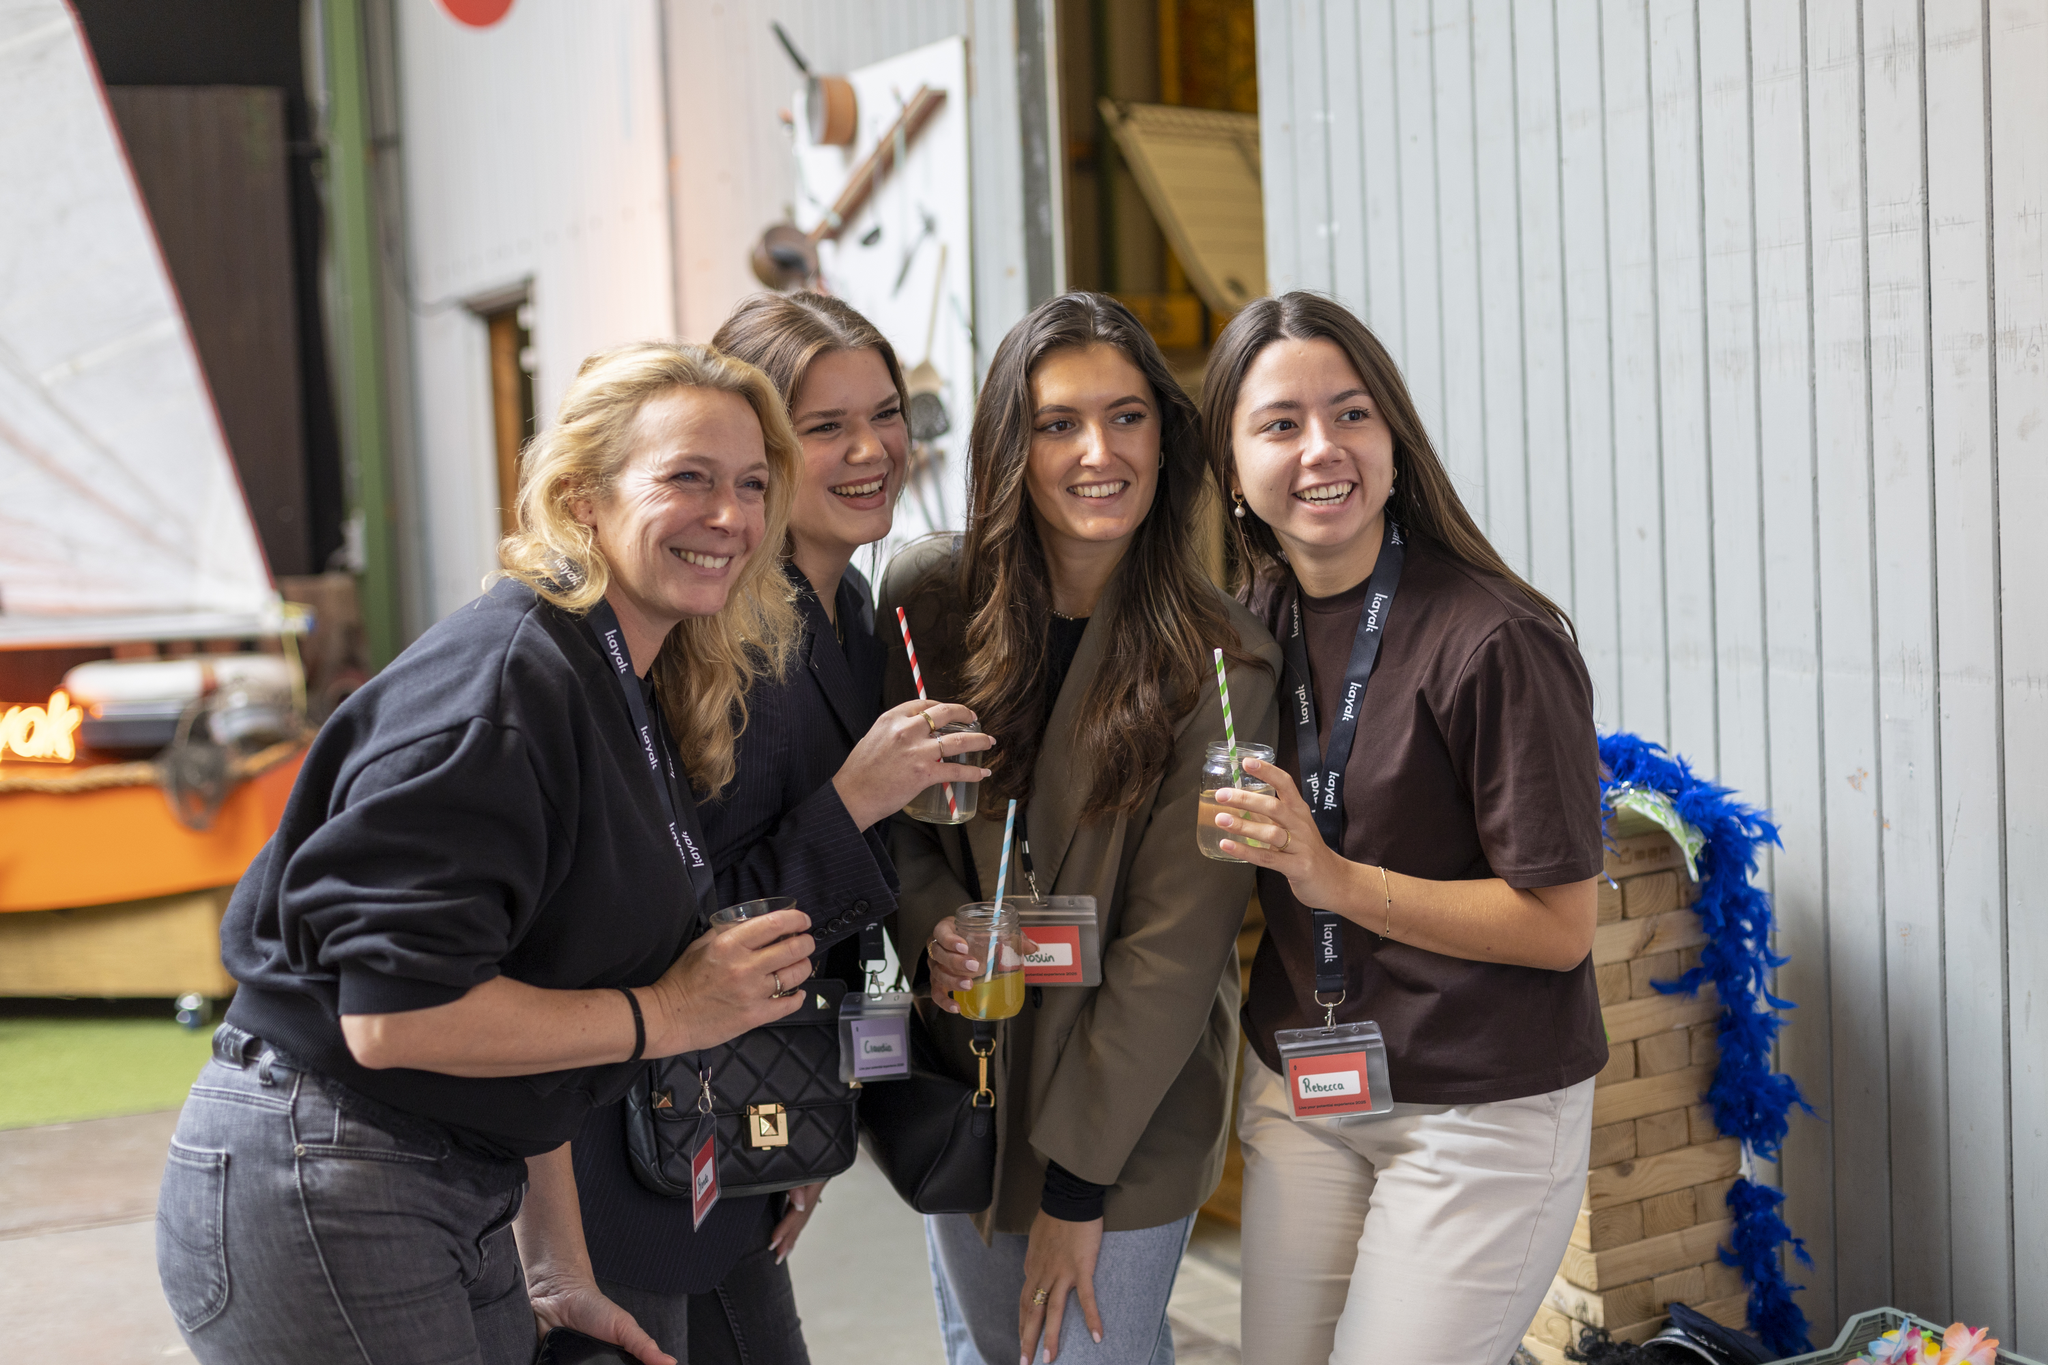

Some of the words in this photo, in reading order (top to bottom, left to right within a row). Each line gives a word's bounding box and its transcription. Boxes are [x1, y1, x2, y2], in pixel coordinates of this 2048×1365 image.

[1291, 598, 1299, 638] kayak
[1365, 592, 1388, 633] kayak
[604, 629, 629, 674] kayak
[1295, 684, 1309, 725] kayak
[1341, 681, 1362, 721] kayak
[640, 725, 658, 770] kayak
[1323, 770, 1340, 810] kayak
[682, 831, 705, 868] kayak
[1321, 923, 1338, 963] kayak
[1302, 1077, 1345, 1093] Rebecca
